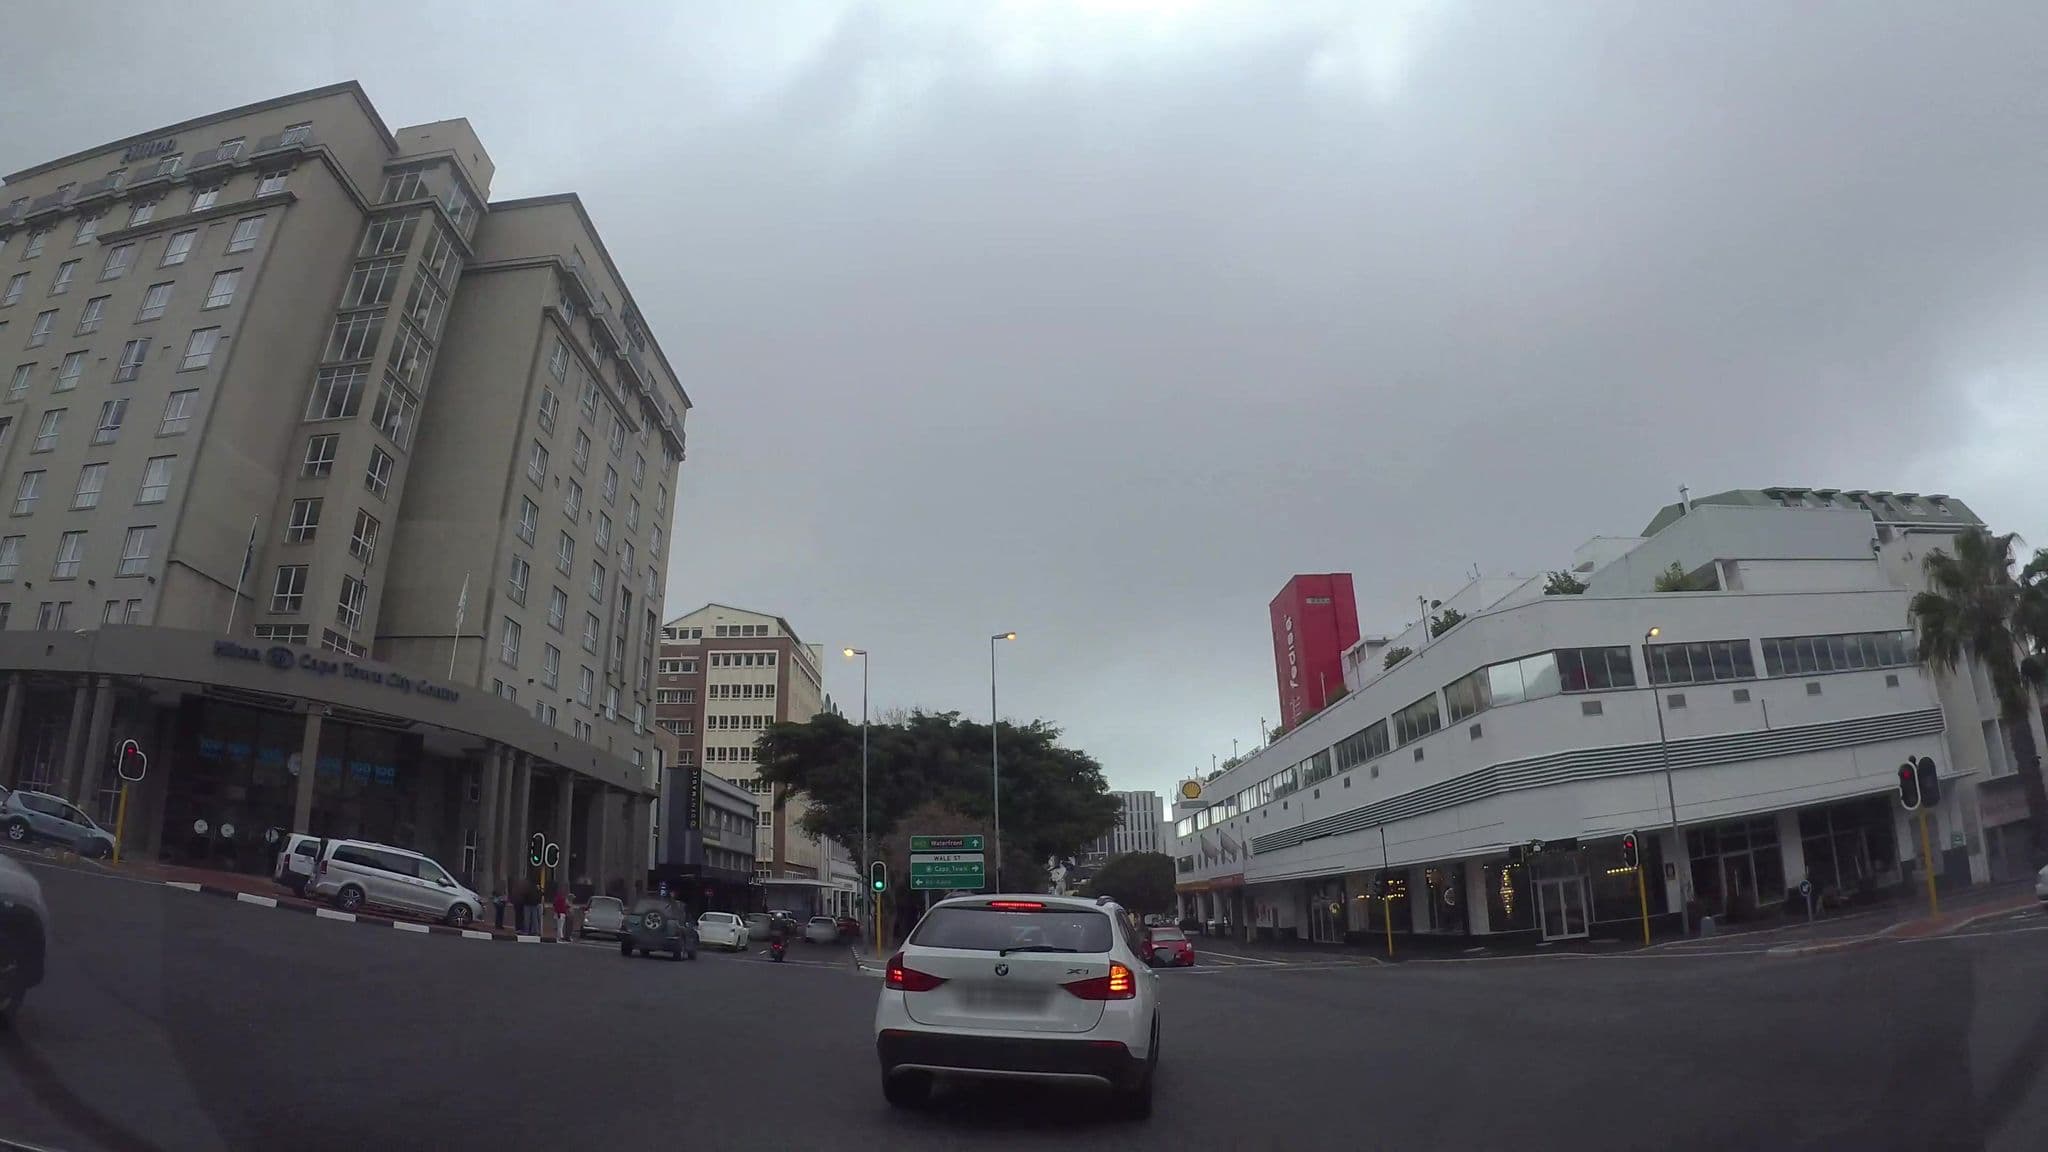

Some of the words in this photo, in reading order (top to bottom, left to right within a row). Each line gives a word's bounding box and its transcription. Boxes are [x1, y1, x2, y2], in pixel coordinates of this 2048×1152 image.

[298, 653, 338, 677] Cape
[343, 662, 384, 684] Town
[385, 672, 411, 694] City
